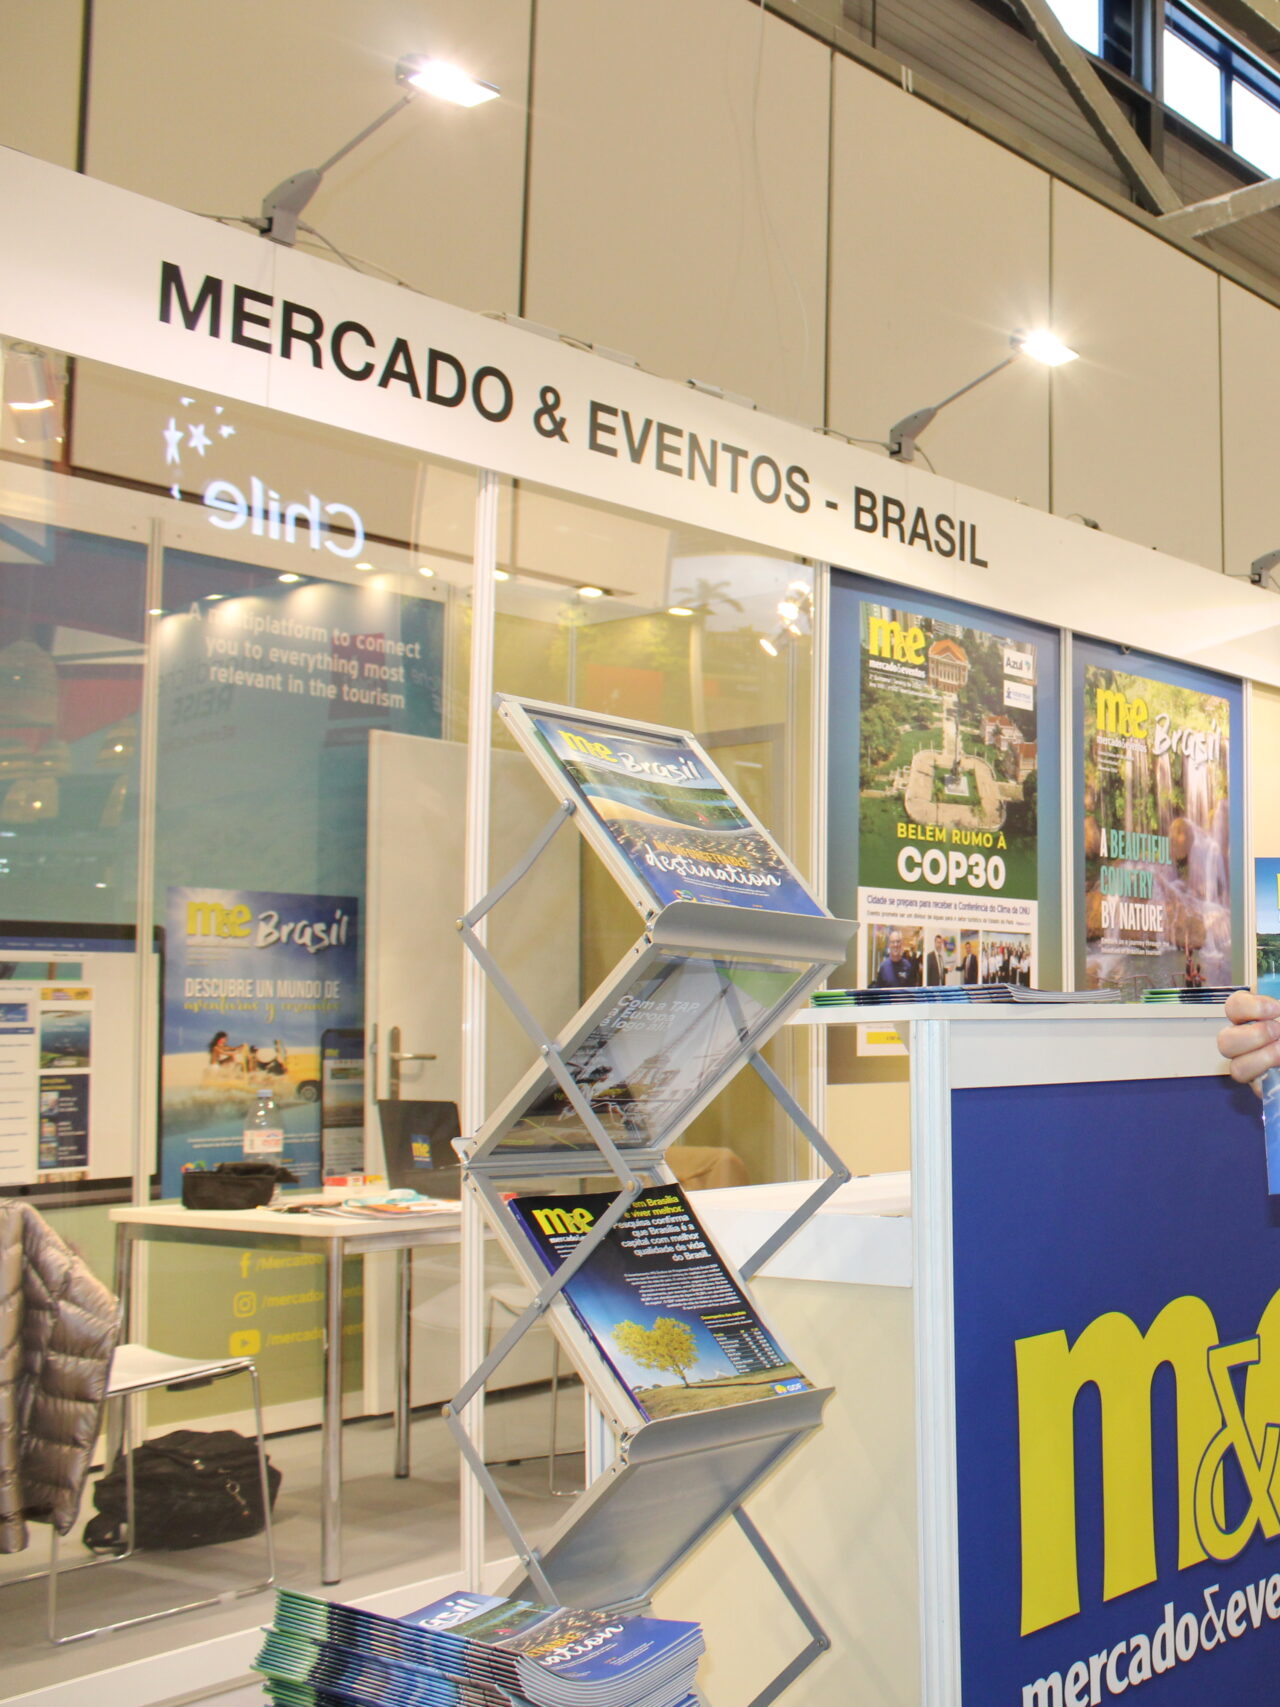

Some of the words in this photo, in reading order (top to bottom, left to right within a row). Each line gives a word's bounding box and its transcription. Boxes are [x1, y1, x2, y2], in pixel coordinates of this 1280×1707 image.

[157, 260, 514, 423] MERCADO
[533, 385, 569, 443] &
[588, 399, 811, 514] EVENTOS
[825, 501, 838, 510] -
[853, 485, 989, 569] BRASIL
[188, 602, 201, 621] A
[208, 607, 327, 643] mtiplatform
[332, 628, 350, 646] to
[356, 634, 421, 659] connect
[869, 616, 926, 665] m&e
[206, 636, 238, 658] you
[243, 641, 262, 659] to
[269, 647, 359, 679] everything
[363, 663, 405, 683] most
[1006, 657, 1023, 670] Azul
[210, 664, 283, 693] relevant
[288, 674, 303, 695] in
[309, 678, 337, 699] the
[341, 684, 405, 709] tourism
[1096, 688, 1149, 739] m&e
[1152, 713, 1222, 766] Brasil
[617, 752, 703, 781] Brasil
[896, 822, 948, 844] BELÉM
[951, 828, 993, 849] RUMO
[1100, 827, 1108, 858] A
[1110, 829, 1172, 865] BEAUTIFUL
[644, 843, 781, 887] destination
[897, 844, 1007, 891] COP30
[1100, 865, 1153, 899] COUNTRY
[867, 895, 887, 905] Cidade
[997, 904, 1011, 913] Clima
[1020, 906, 1031, 915] ONU
[1101, 900, 1116, 929] BY
[1120, 902, 1164, 932] NATURE
[186, 901, 252, 938] m&e
[255, 909, 348, 954] Brasil
[184, 978, 253, 998] DESCUBRE
[256, 979, 274, 998] UN
[276, 979, 321, 999] MUNDO
[324, 980, 341, 999] DE
[617, 994, 652, 1009] Com
[611, 1017, 644, 1032] logo
[620, 1007, 676, 1022] Europa
[631, 1209, 651, 1217] viver
[652, 1206, 684, 1216] melhor.
[645, 1195, 679, 1207] Brasília
[531, 1208, 594, 1235] m&e
[632, 1228, 649, 1238] que
[650, 1224, 680, 1235] Brasília
[651, 1214, 690, 1225] confirma
[621, 1238, 650, 1249] capital
[651, 1236, 669, 1245] com
[670, 1232, 699, 1243] melhor
[634, 1244, 674, 1257] qualidade
[675, 1242, 687, 1251] de
[688, 1240, 706, 1250] vida
[672, 1253, 684, 1262] do
[684, 1249, 711, 1261] Brasil.
[419, 1598, 485, 1628] asil
